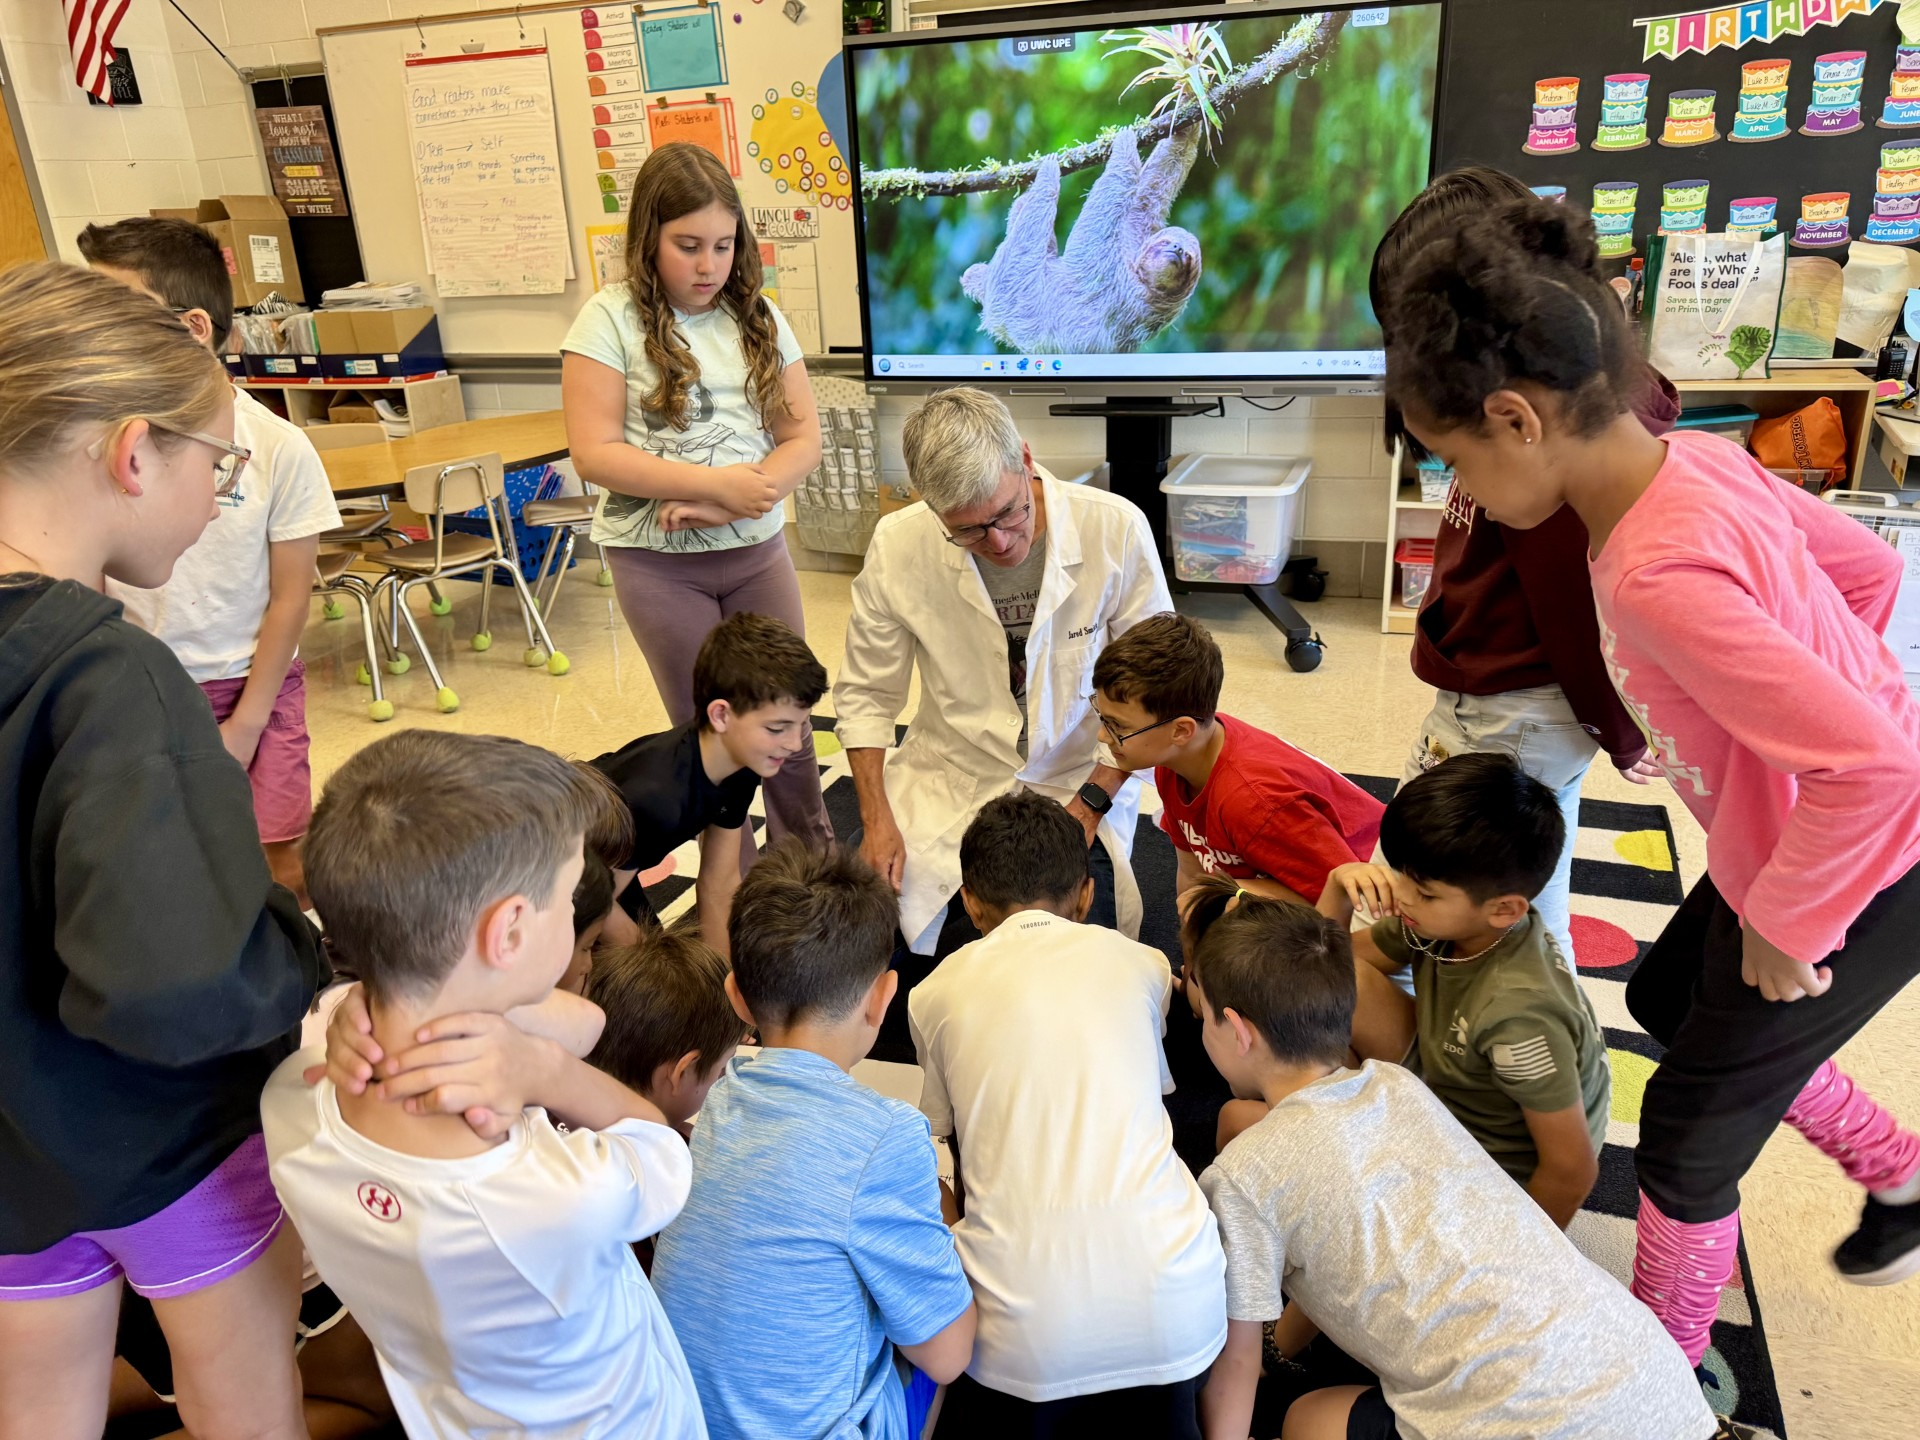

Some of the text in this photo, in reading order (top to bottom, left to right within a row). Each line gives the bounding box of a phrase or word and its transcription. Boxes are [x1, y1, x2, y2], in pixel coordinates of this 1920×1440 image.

[1030, 38, 1071, 49] UWC UPE
[272, 114, 297, 123] WHAT
[1900, 110, 1920, 118] JUNE
[1822, 118, 1842, 126] MAY
[268, 120, 318, 137] love most
[1674, 129, 1704, 137] MARCH
[1748, 124, 1770, 133] APRIL
[1535, 137, 1569, 145] JANUARY
[1603, 133, 1640, 143] FEBRUARY
[286, 178, 331, 196] SHARE
[295, 204, 333, 214] IT WITH
[752, 208, 791, 224] LUNCH
[768, 222, 817, 237] COUNT
[1799, 231, 1843, 240] NOVEMBER
[1715, 252, 1747, 262] what
[1669, 269, 1691, 277] are
[1718, 264, 1760, 275] Whoe
[1666, 296, 1687, 304] Save
[1713, 298, 1732, 306] gree
[1704, 306, 1722, 314] Day.
[1020, 589, 1040, 601] Mell
